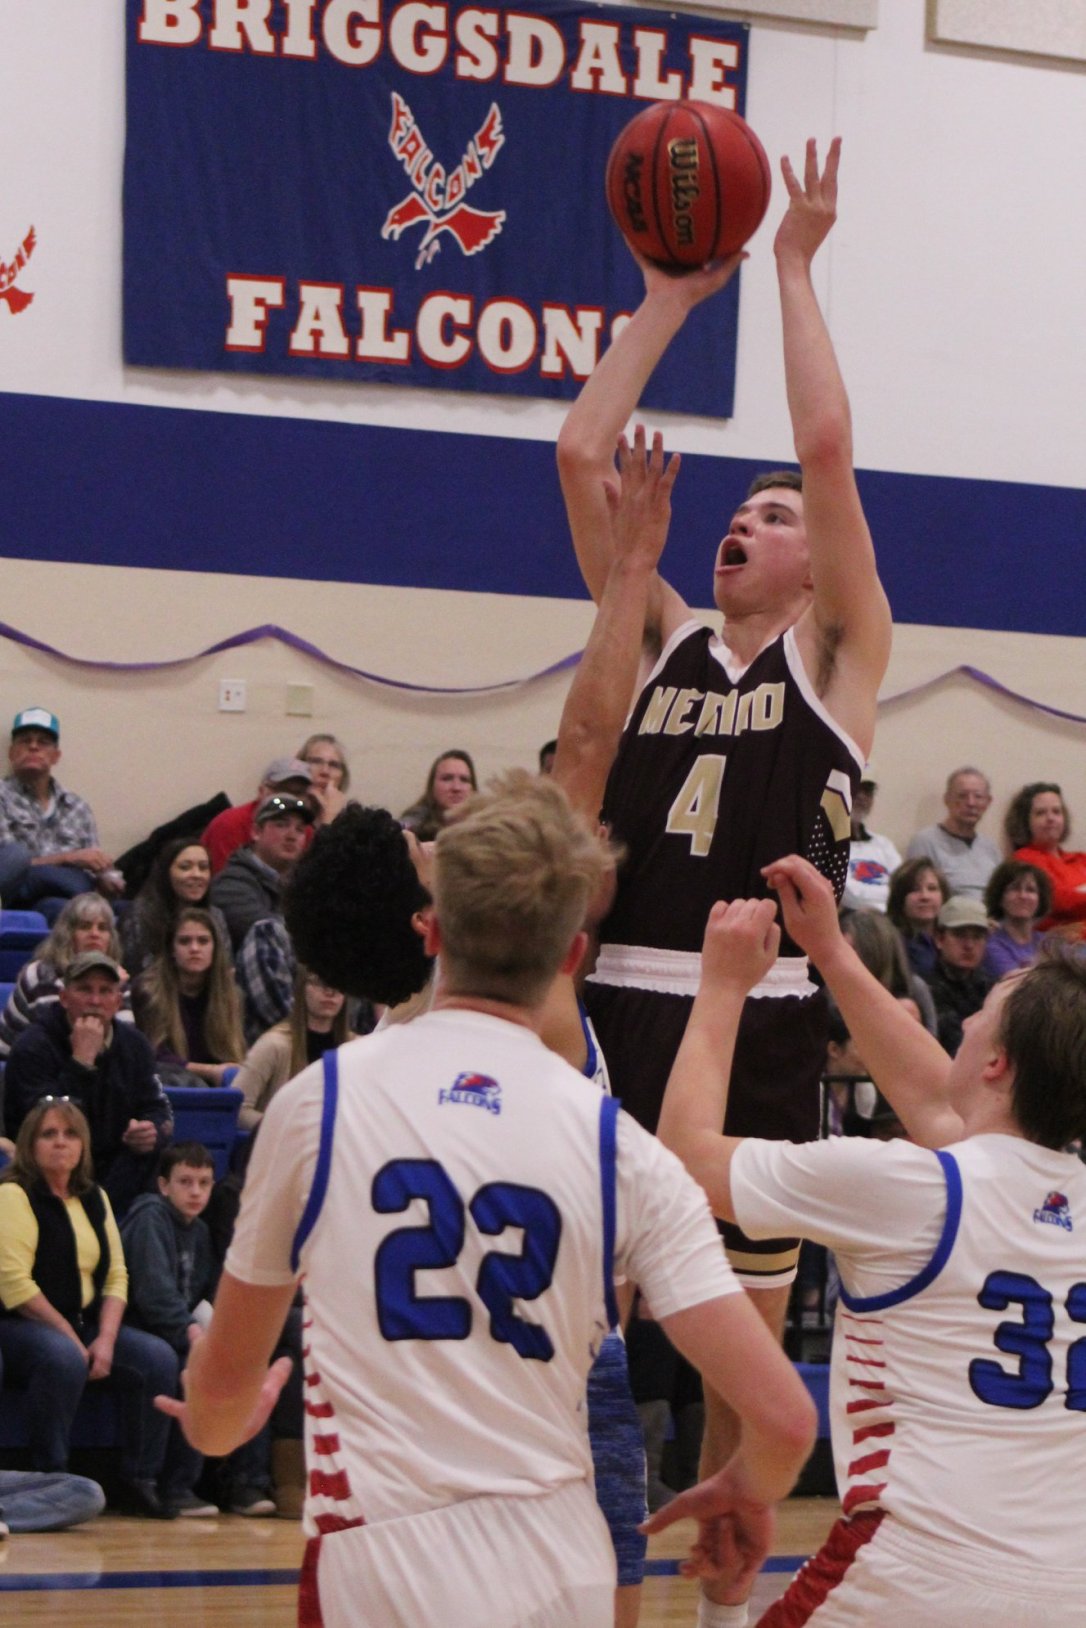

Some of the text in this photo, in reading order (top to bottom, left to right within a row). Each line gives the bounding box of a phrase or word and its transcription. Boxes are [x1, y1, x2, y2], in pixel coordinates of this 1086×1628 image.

[138, 0, 740, 112] BRIGGSDALE
[388, 91, 505, 211] FALCONS
[667, 135, 700, 246] Wilson
[665, 753, 727, 856] 4
[437, 1087, 502, 1115] FALCONS
[371, 1157, 563, 1363] 22
